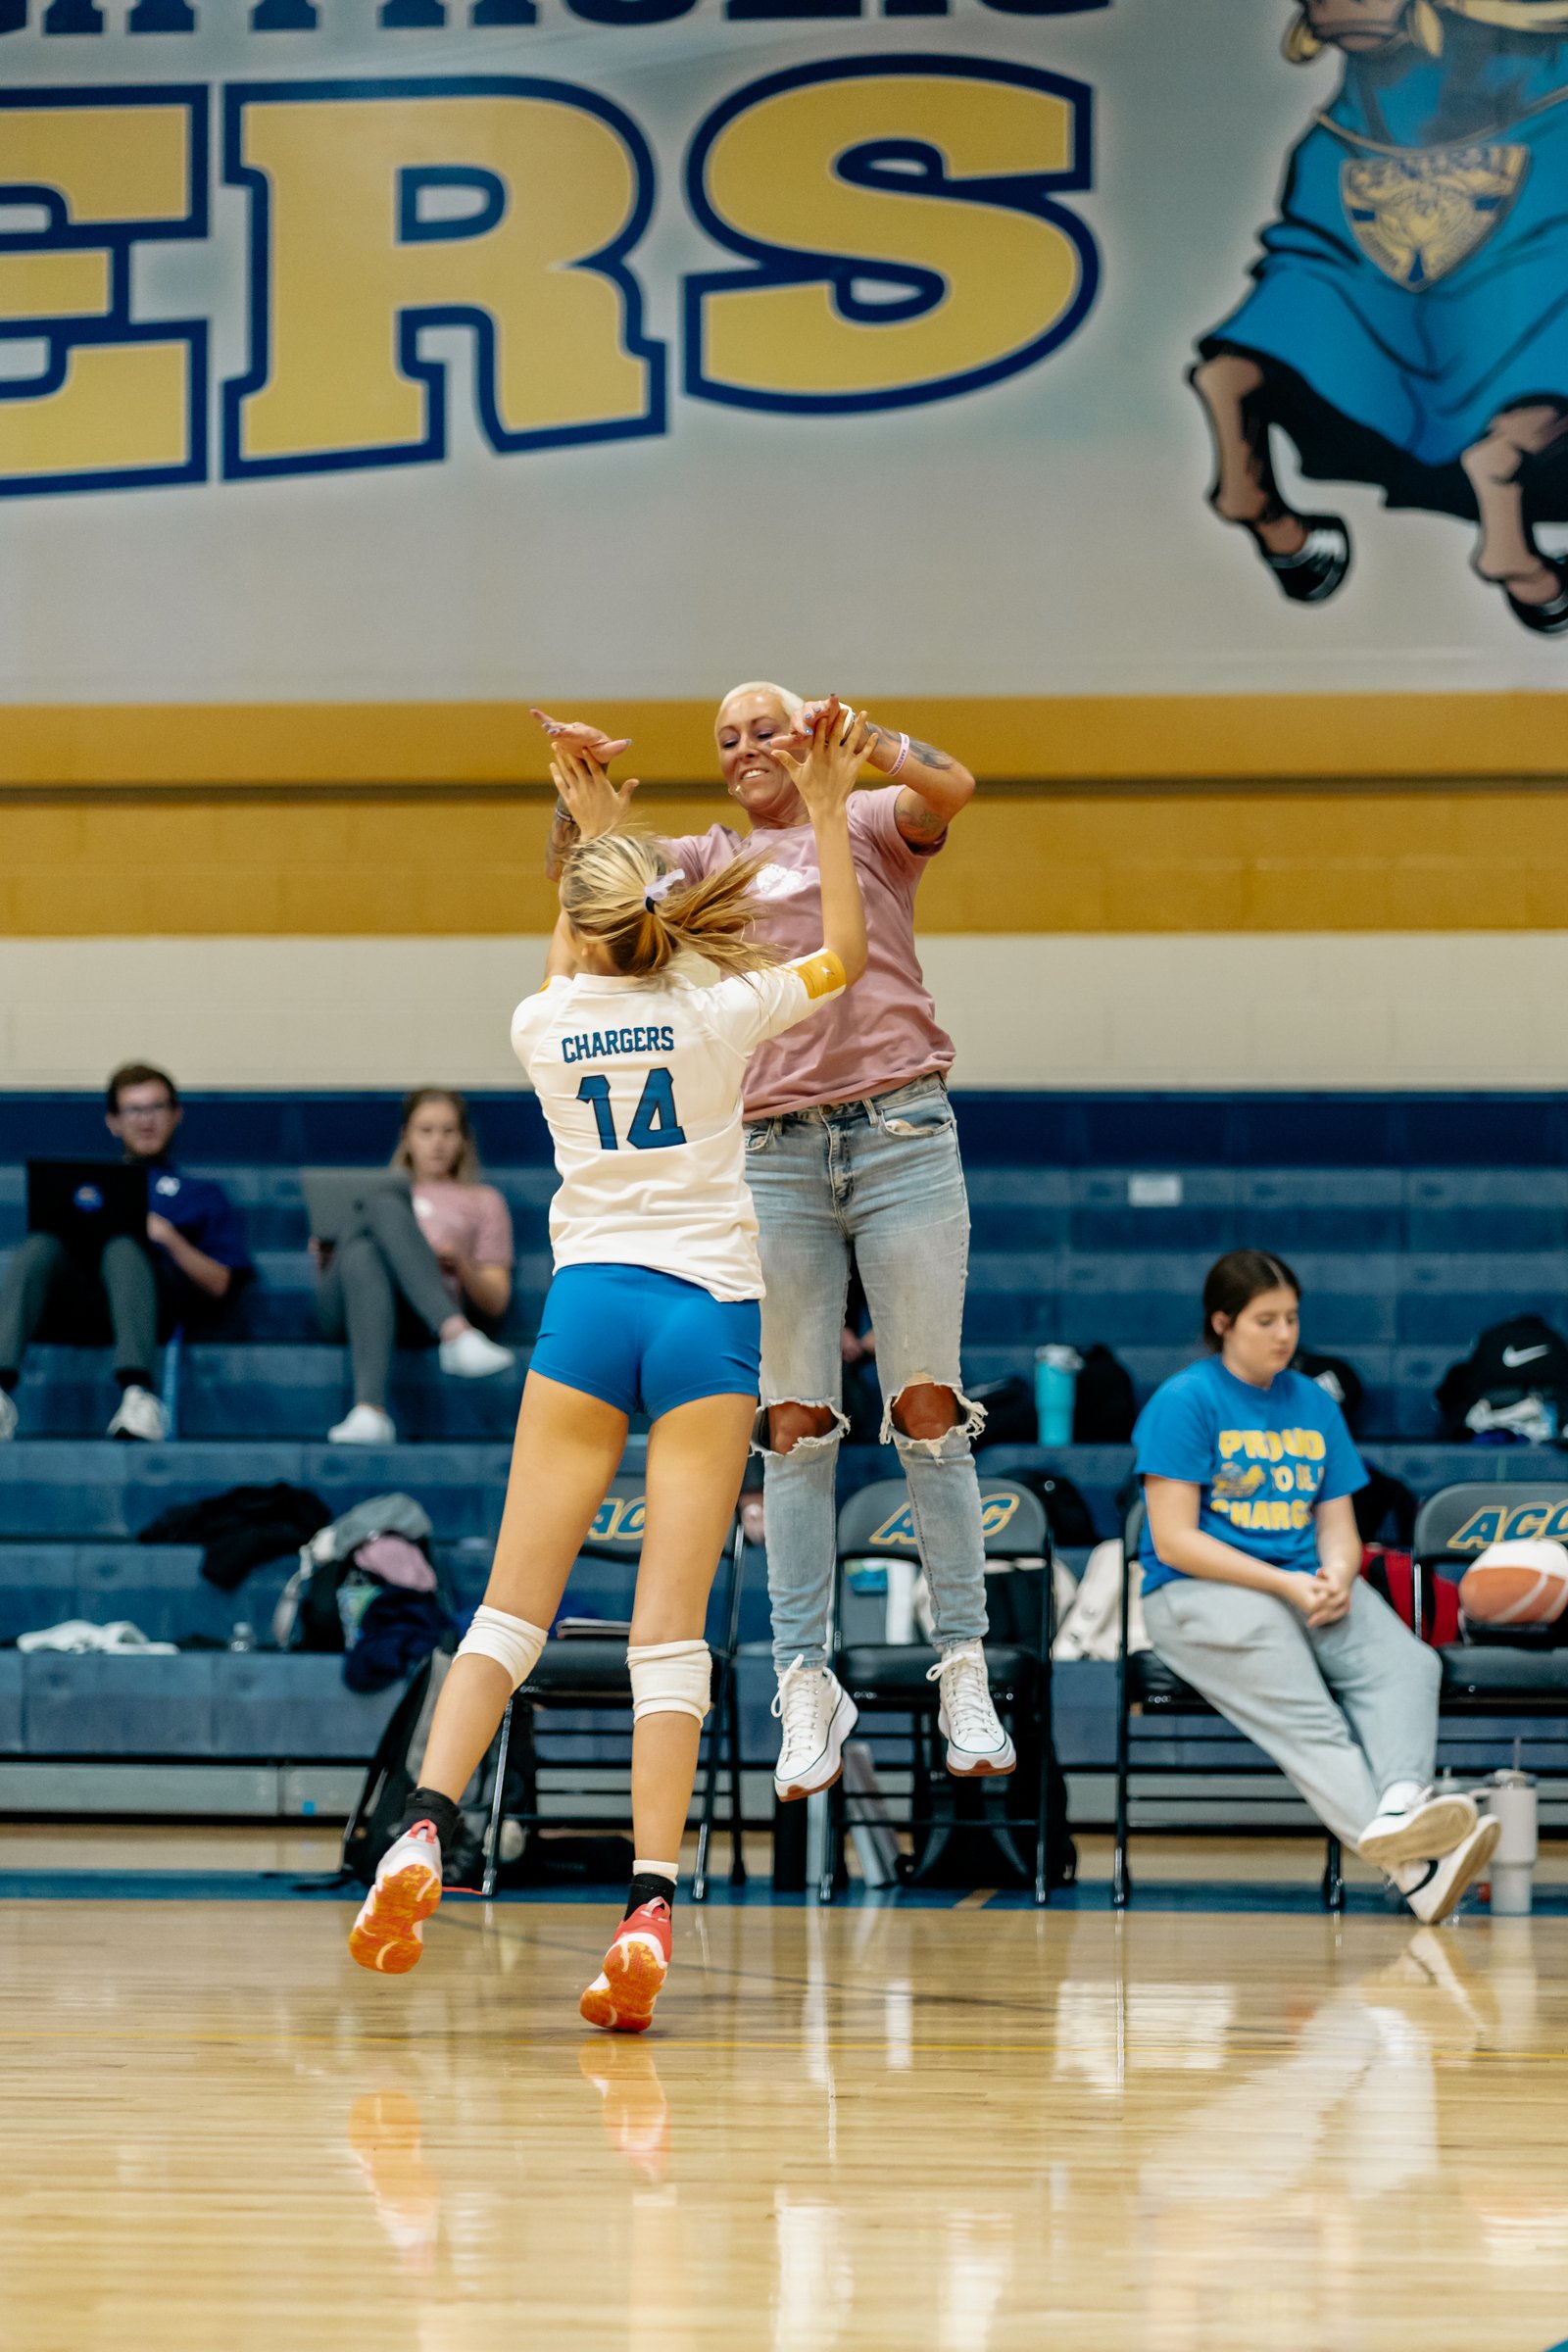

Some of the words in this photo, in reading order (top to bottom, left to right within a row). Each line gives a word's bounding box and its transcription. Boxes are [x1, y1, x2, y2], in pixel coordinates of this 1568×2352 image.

[562, 1026, 674, 1063] CHARGERS
[575, 1066, 687, 1151] 14
[1218, 1428, 1326, 1461] PROUD
[868, 1493, 1020, 1545] AC
